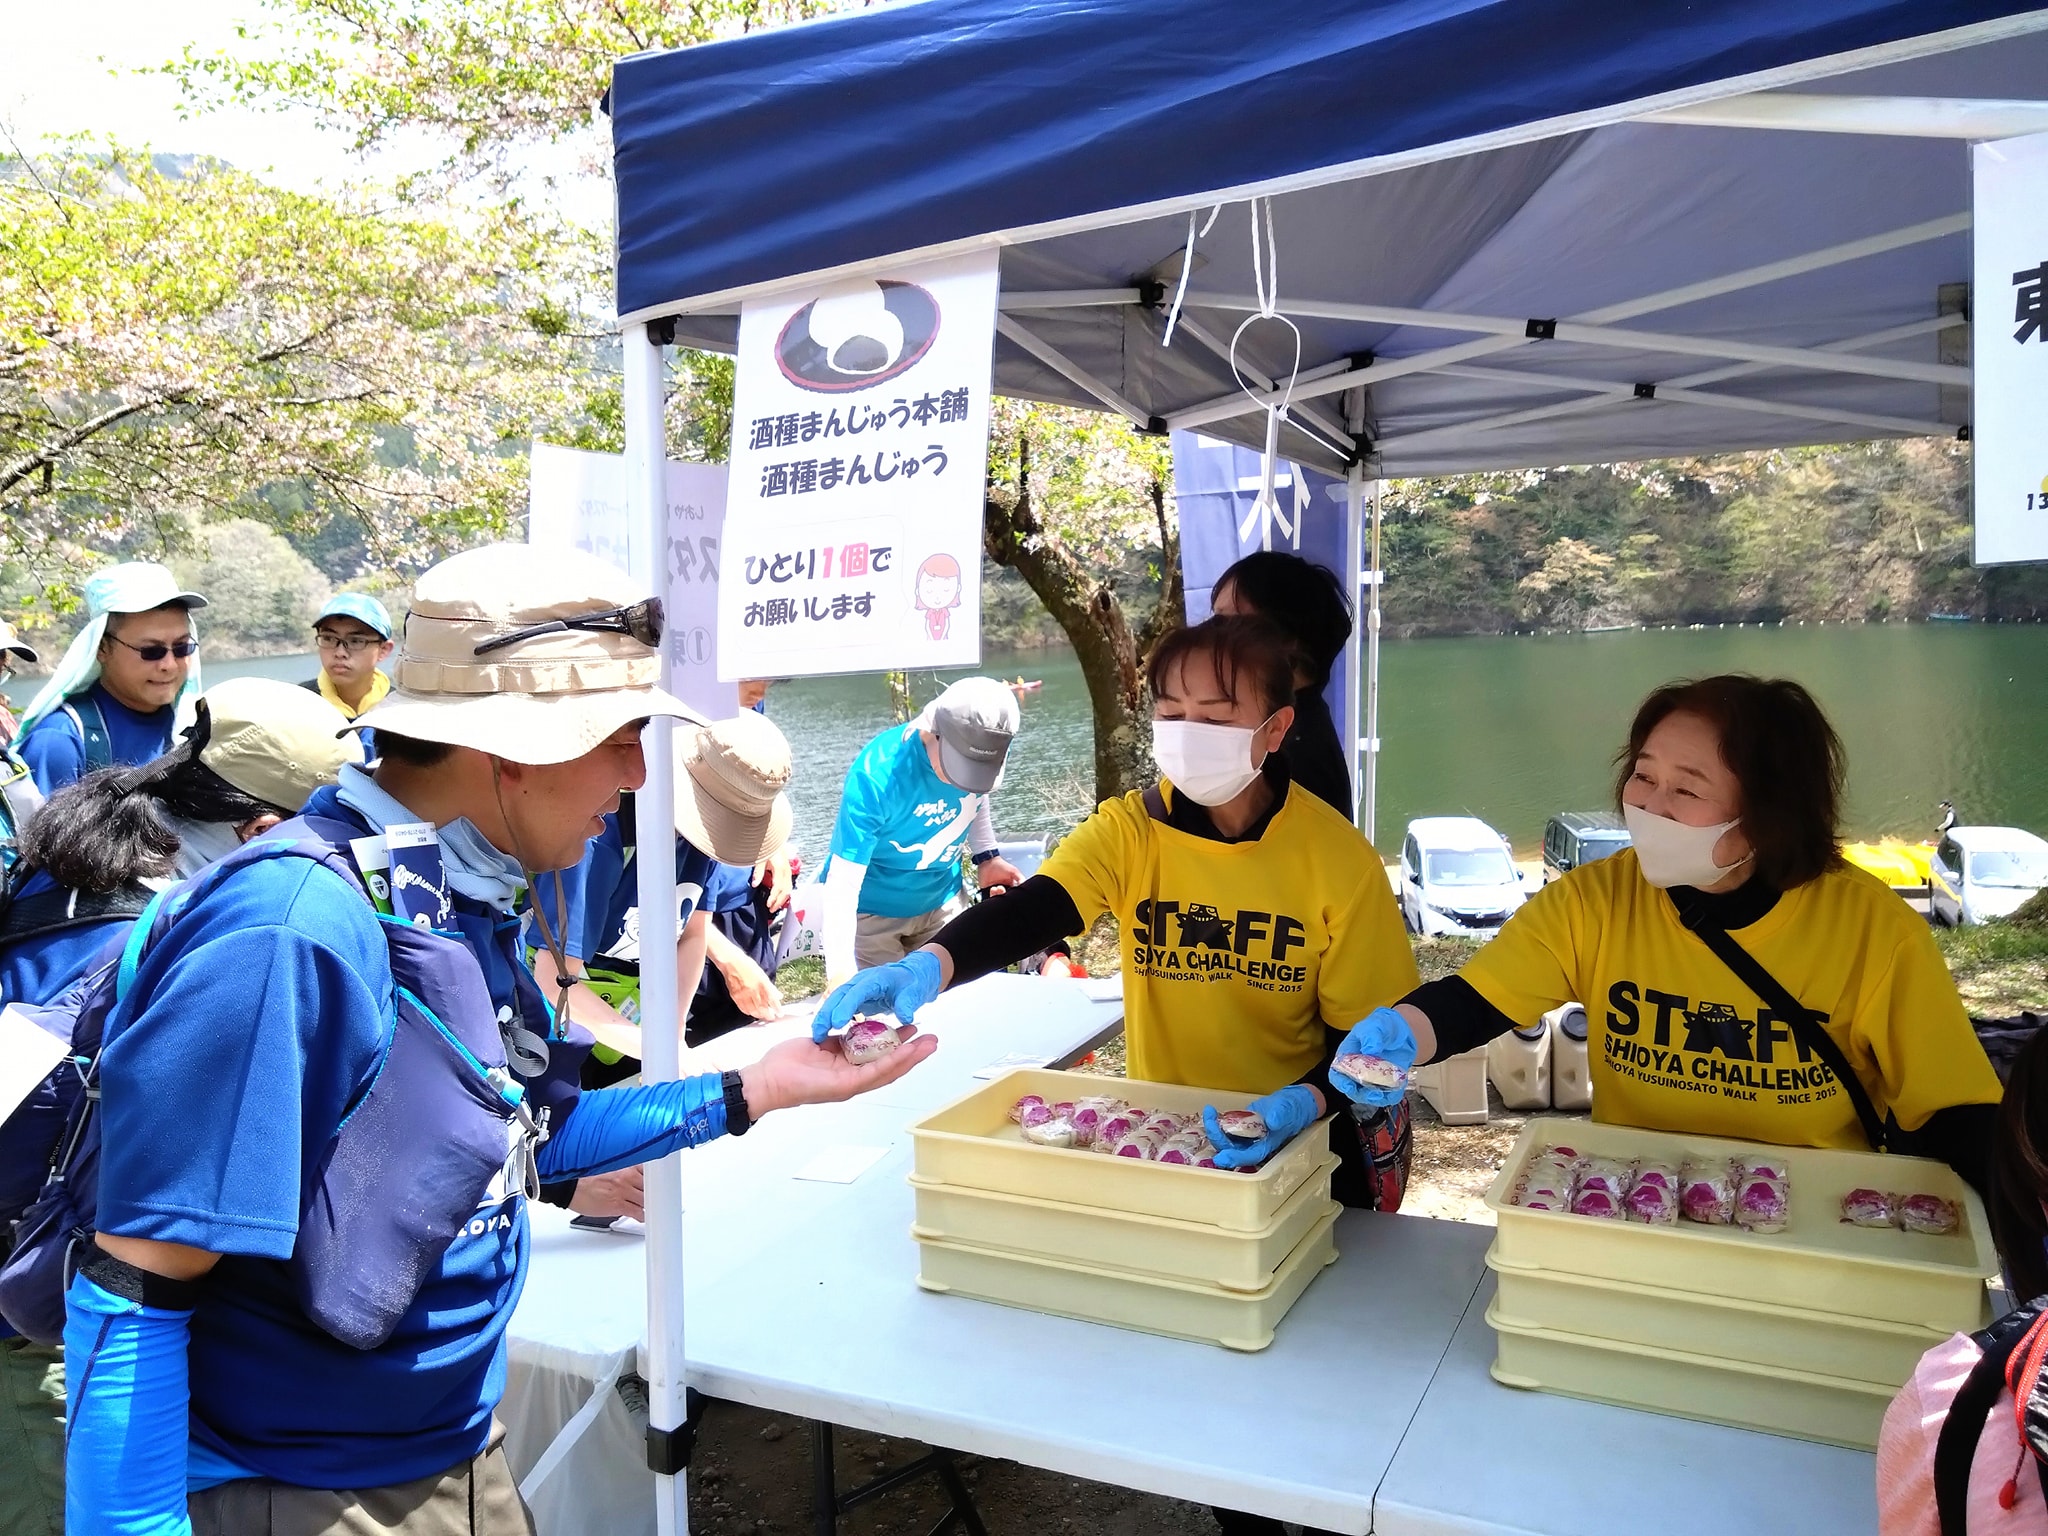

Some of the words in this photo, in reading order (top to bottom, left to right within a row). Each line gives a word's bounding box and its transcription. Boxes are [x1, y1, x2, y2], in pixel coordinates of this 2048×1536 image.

[748, 387, 969, 450] 酒種まんじゅう本舗
[759, 444, 949, 498] 酒種まんじゅう
[744, 542, 892, 586] ひとり1個で
[743, 592, 877, 627] お願いします
[1187, 950, 1307, 983] CHALLENGE
[1209, 972, 1233, 983] WALK
[1246, 979, 1275, 992] SINCE
[1278, 984, 1303, 993] 2015
[1604, 1033, 1684, 1076] SHIOYA
[1691, 1058, 1834, 1091] CHALLENGE
[1604, 1055, 1635, 1078] SHIOYA
[1637, 1069, 1718, 1095] YUSUINOSATO
[1723, 1087, 1757, 1102] WALK
[1777, 1093, 1811, 1105] SINCE
[1815, 1086, 1838, 1102] 2015
